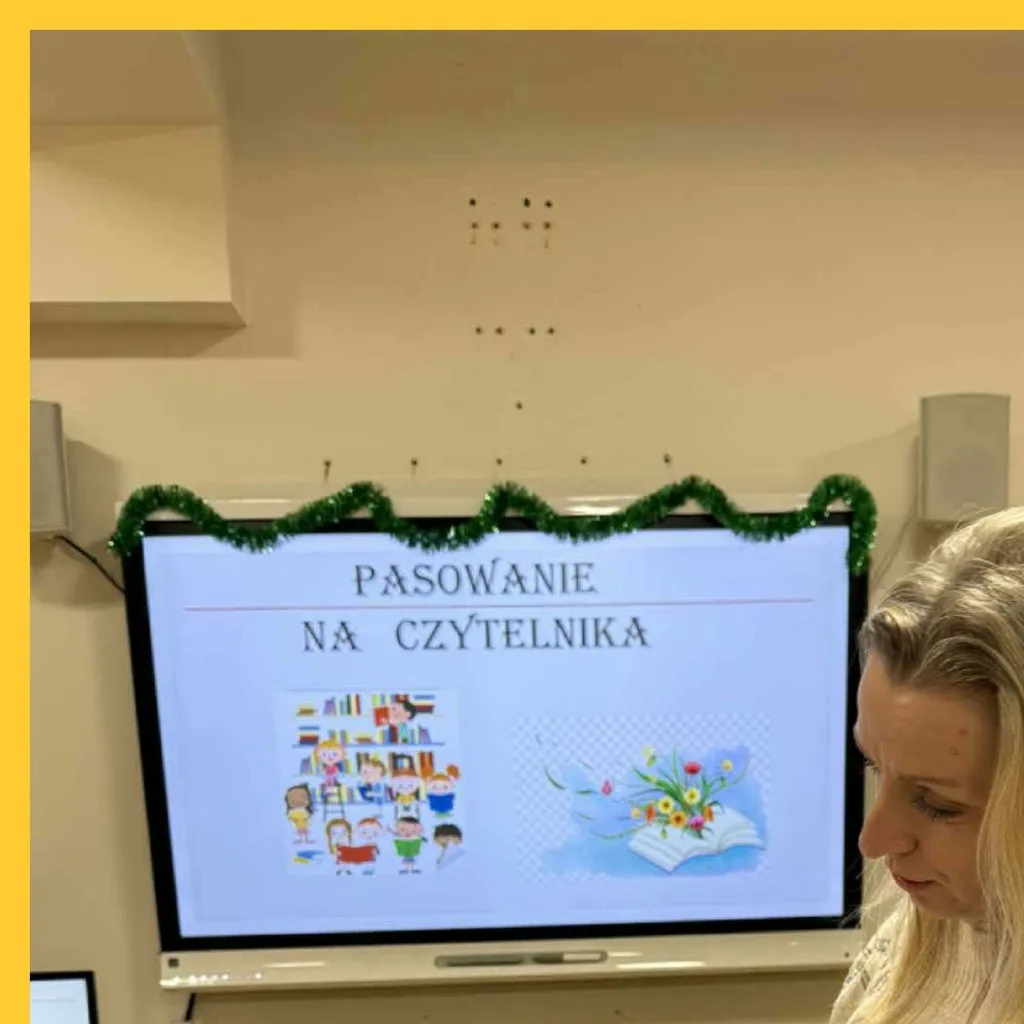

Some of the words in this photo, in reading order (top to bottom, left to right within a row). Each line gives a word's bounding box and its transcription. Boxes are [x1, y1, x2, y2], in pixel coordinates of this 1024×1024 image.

[352, 556, 598, 599] PASOWANIE
[302, 620, 362, 654] NA
[395, 612, 652, 653] CZYTELNIKA
